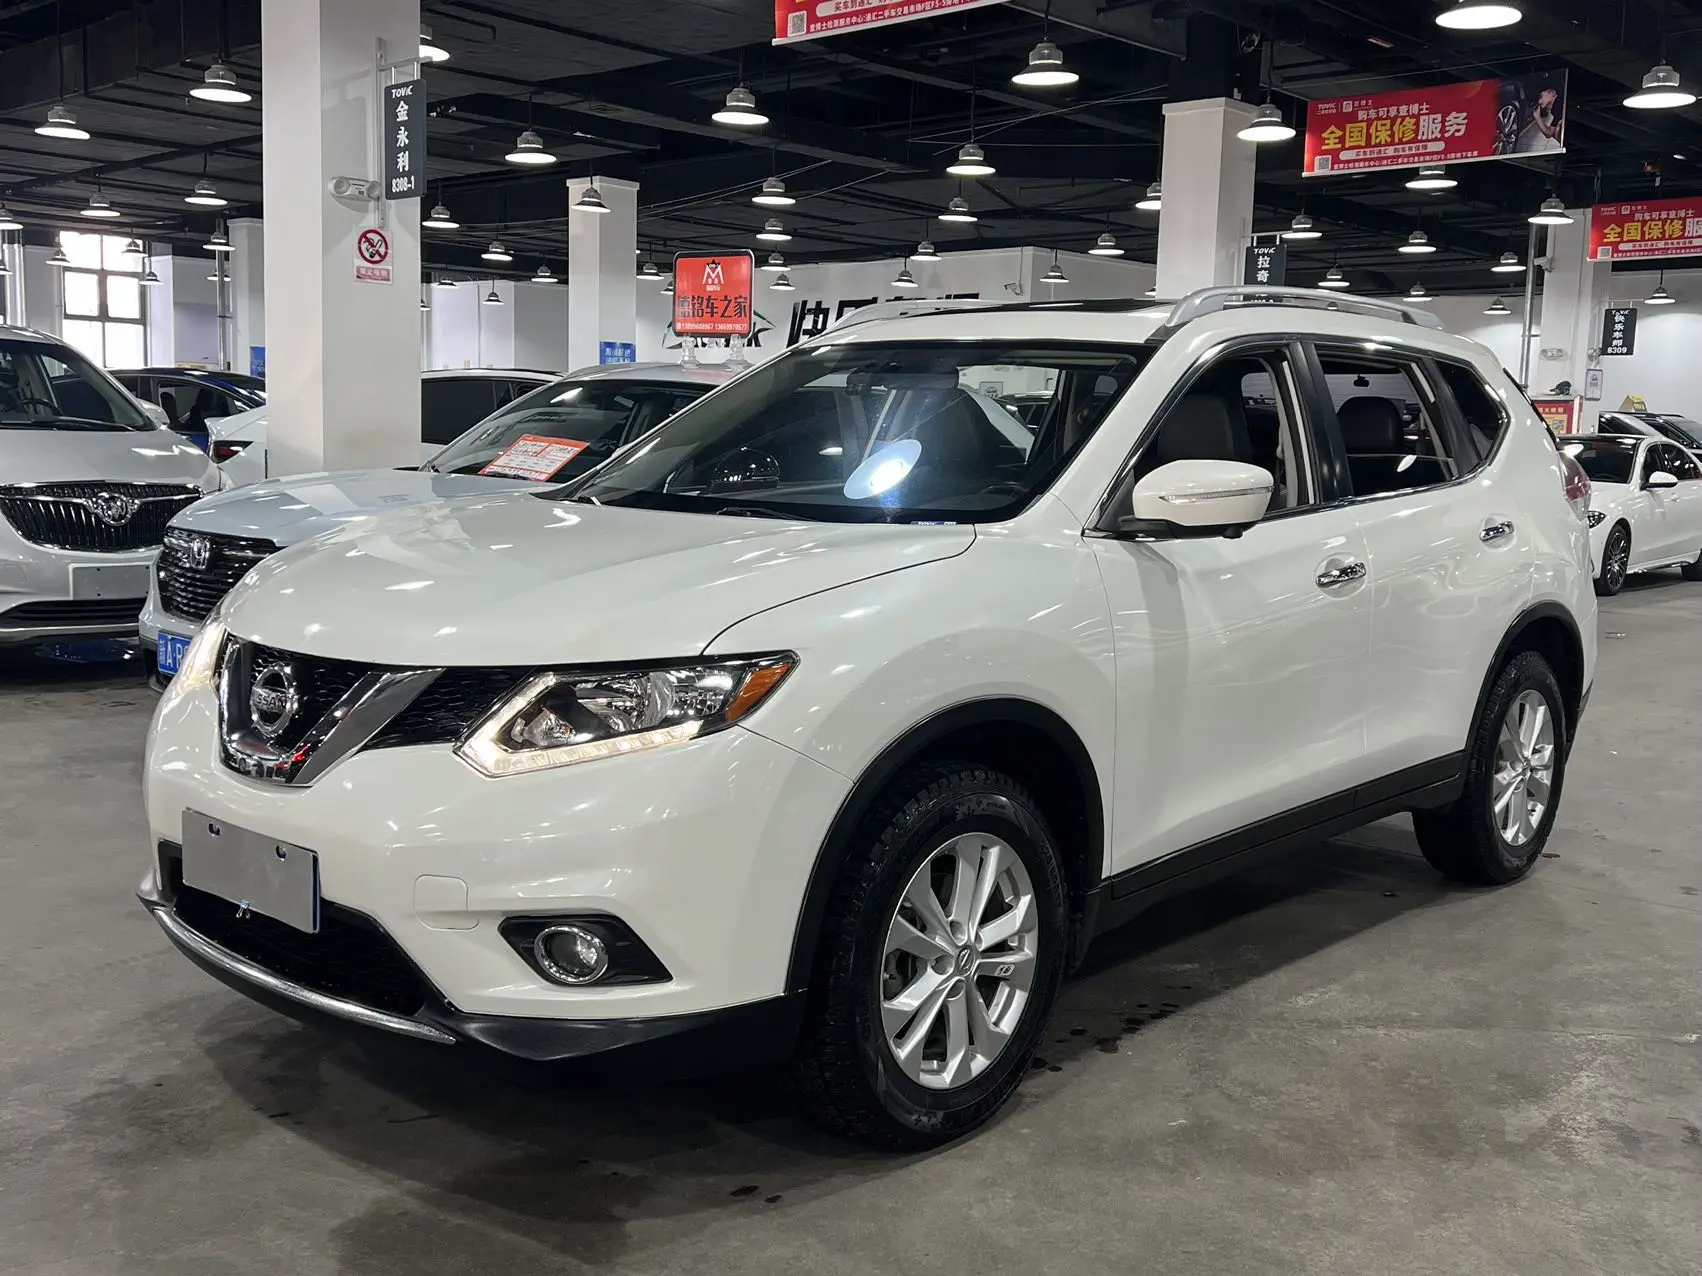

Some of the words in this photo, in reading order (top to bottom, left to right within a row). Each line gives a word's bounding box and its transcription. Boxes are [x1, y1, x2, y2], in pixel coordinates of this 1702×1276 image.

[391, 85, 413, 98] TOVIC
[1357, 102, 1430, 121] 购车可享查博士
[395, 100, 409, 172] 金永利
[1320, 111, 1468, 150] 全国保修服务
[391, 176, 415, 193] 8308-1
[1253, 247, 1276, 255] TOVIC
